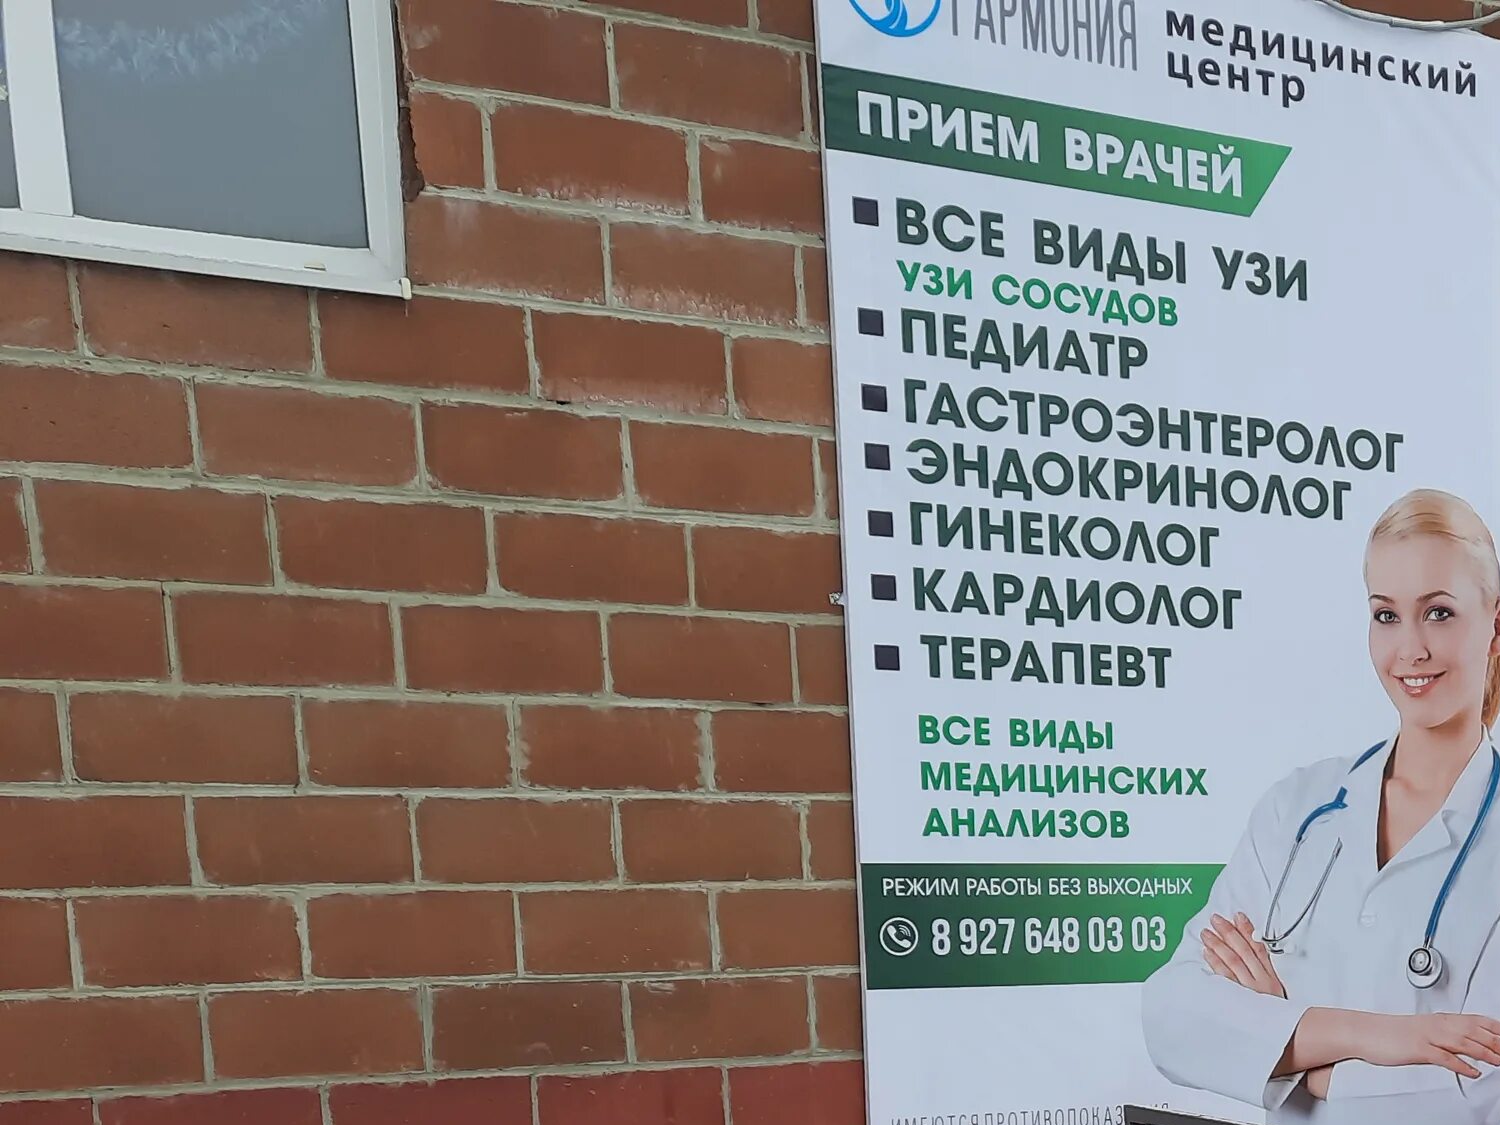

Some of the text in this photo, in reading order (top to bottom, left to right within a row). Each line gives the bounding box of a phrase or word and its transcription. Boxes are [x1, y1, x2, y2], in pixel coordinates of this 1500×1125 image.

[1166, 10, 1478, 98] медицинский
[1166, 45, 1305, 107] центр
[857, 90, 1243, 197] ПРИЕМ ВРАЧЕЙ
[895, 197, 1308, 300] ВСЕ ВИДЫ УЗИ
[896, 260, 1178, 326] УЗИ СОСУДОВ
[900, 308, 1148, 379] ПЕДИАТР
[904, 378, 1404, 473] ГАСТРОЭНТЕРОЛОГ
[906, 438, 1352, 521] ЭНДОКРИНОЛОГ
[909, 502, 1220, 568] ГИНЕКОЛОГ
[912, 566, 1242, 630] КАРДИОЛОГ
[920, 634, 1172, 689] ТЕРАПЕВТ
[918, 714, 1113, 754] ВСЕ ВИДЫ
[920, 761, 1209, 797] МЕДИЦИНСКИХ
[922, 807, 1130, 838] АНАЛИЗОВ
[882, 876, 1193, 897] РЕЖИМ РАБОТЫ БЕЗ ВЫХОДНЫХ
[931, 915, 1166, 956] 8 927 648 03 03
